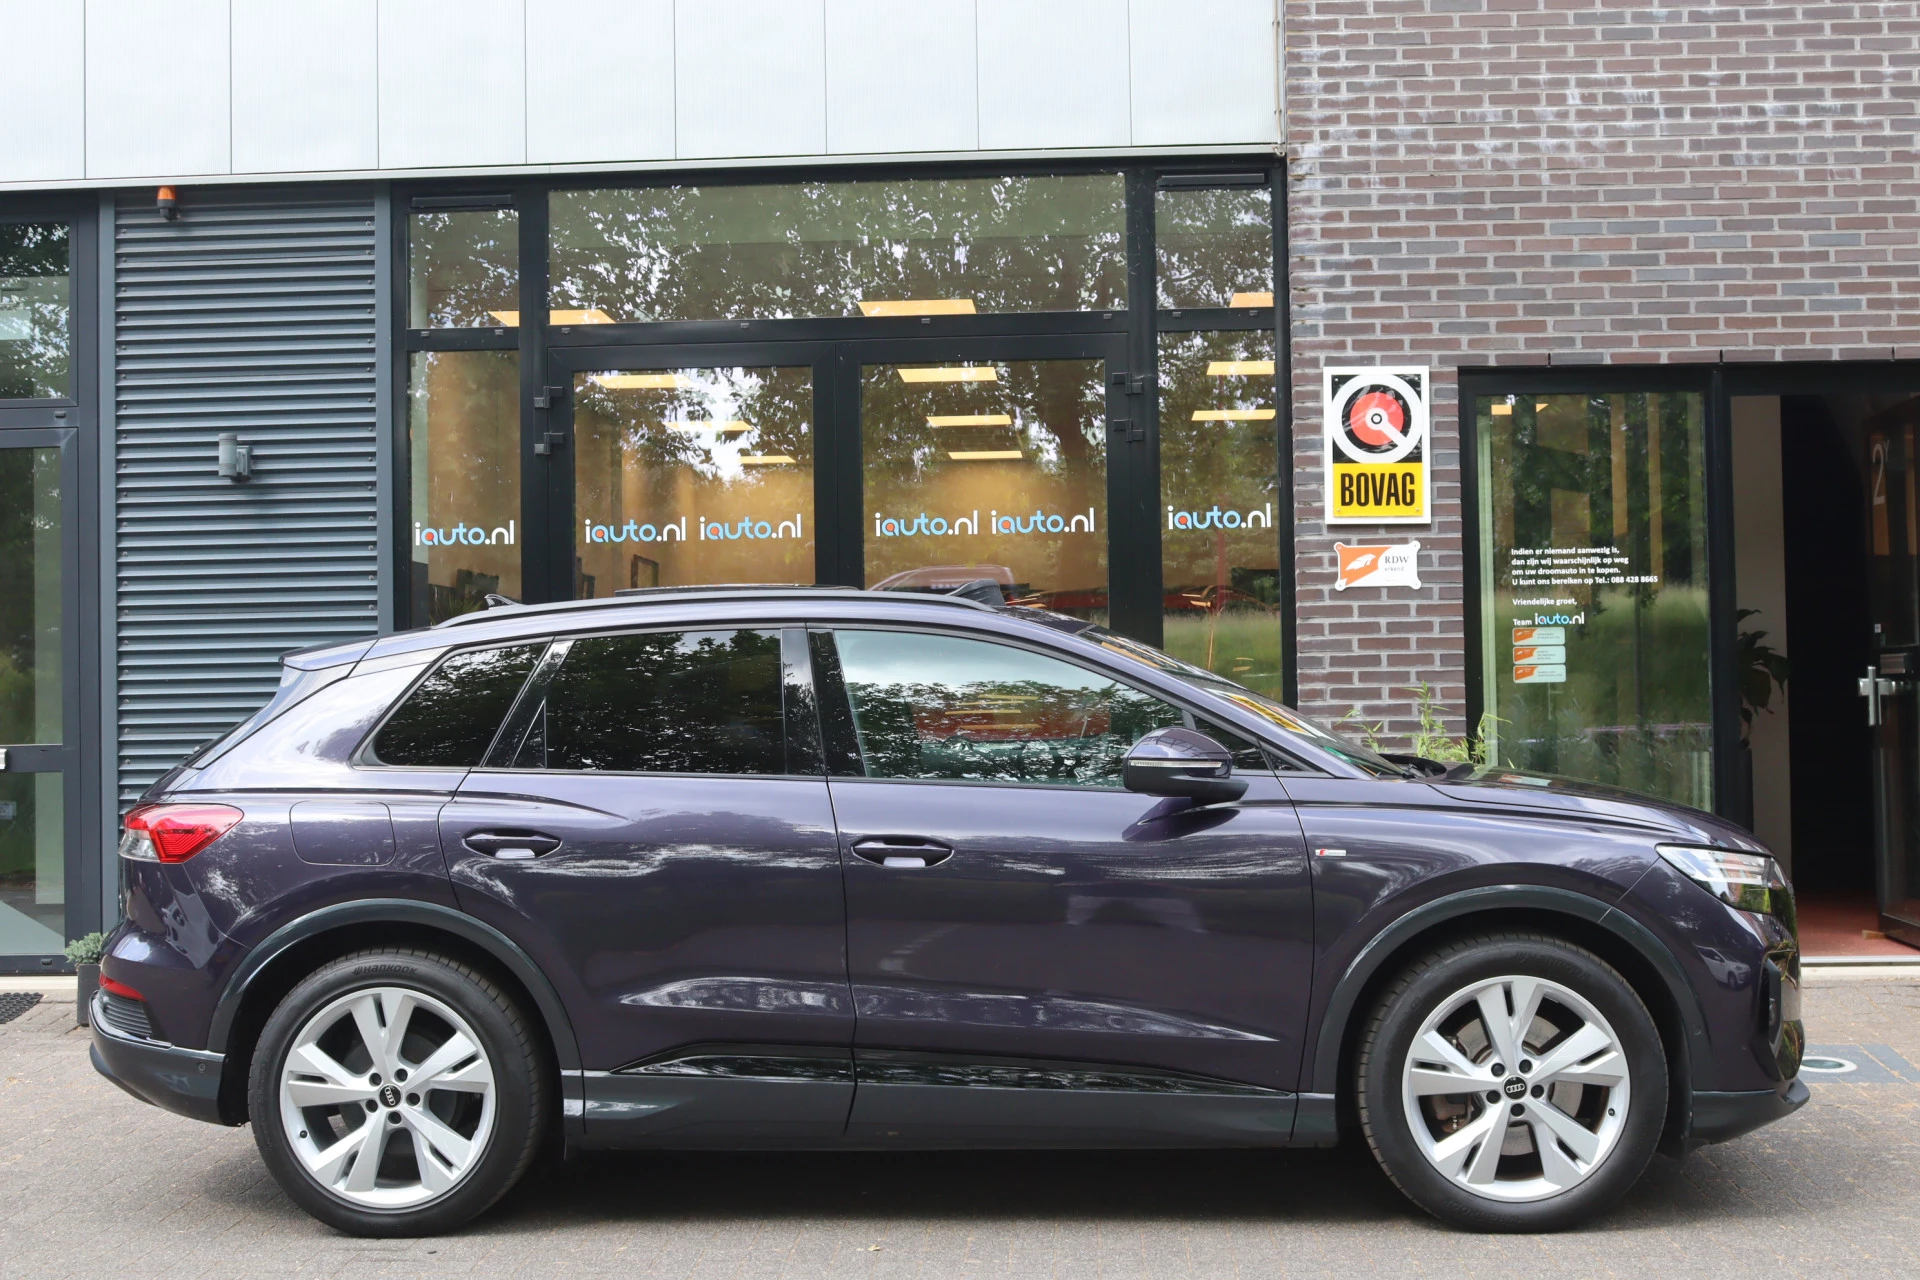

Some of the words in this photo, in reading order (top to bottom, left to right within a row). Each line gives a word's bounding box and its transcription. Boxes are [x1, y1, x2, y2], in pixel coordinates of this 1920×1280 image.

[1340, 472, 1415, 506] BOVAG
[585, 516, 687, 543] iauto.nl
[700, 513, 802, 540] iauto.nl
[875, 510, 978, 537] iauto.nl
[991, 507, 1095, 534] iauto.nl
[1167, 503, 1272, 530] iauto.nl
[414, 519, 515, 546] iauto.nl
[1384, 555, 1410, 564] RDW
[1511, 547, 1534, 555] Indien
[1544, 547, 1576, 555] niemand
[1577, 546, 1610, 555] aanwezig
[1611, 546, 1620, 554] is,
[1526, 557, 1539, 566] zijn
[1540, 557, 1552, 566] wij
[1553, 556, 1601, 565] waarschijnlijk
[1602, 557, 1613, 565] op
[1613, 557, 1629, 565] weg
[1537, 567, 1578, 575] droomauto
[1596, 566, 1621, 574] kopen.
[1512, 597, 1555, 606] Vriendelijke
[1556, 597, 1578, 606] groet,
[1512, 618, 1533, 626] Team
[1534, 611, 1585, 625] iauto.nl
